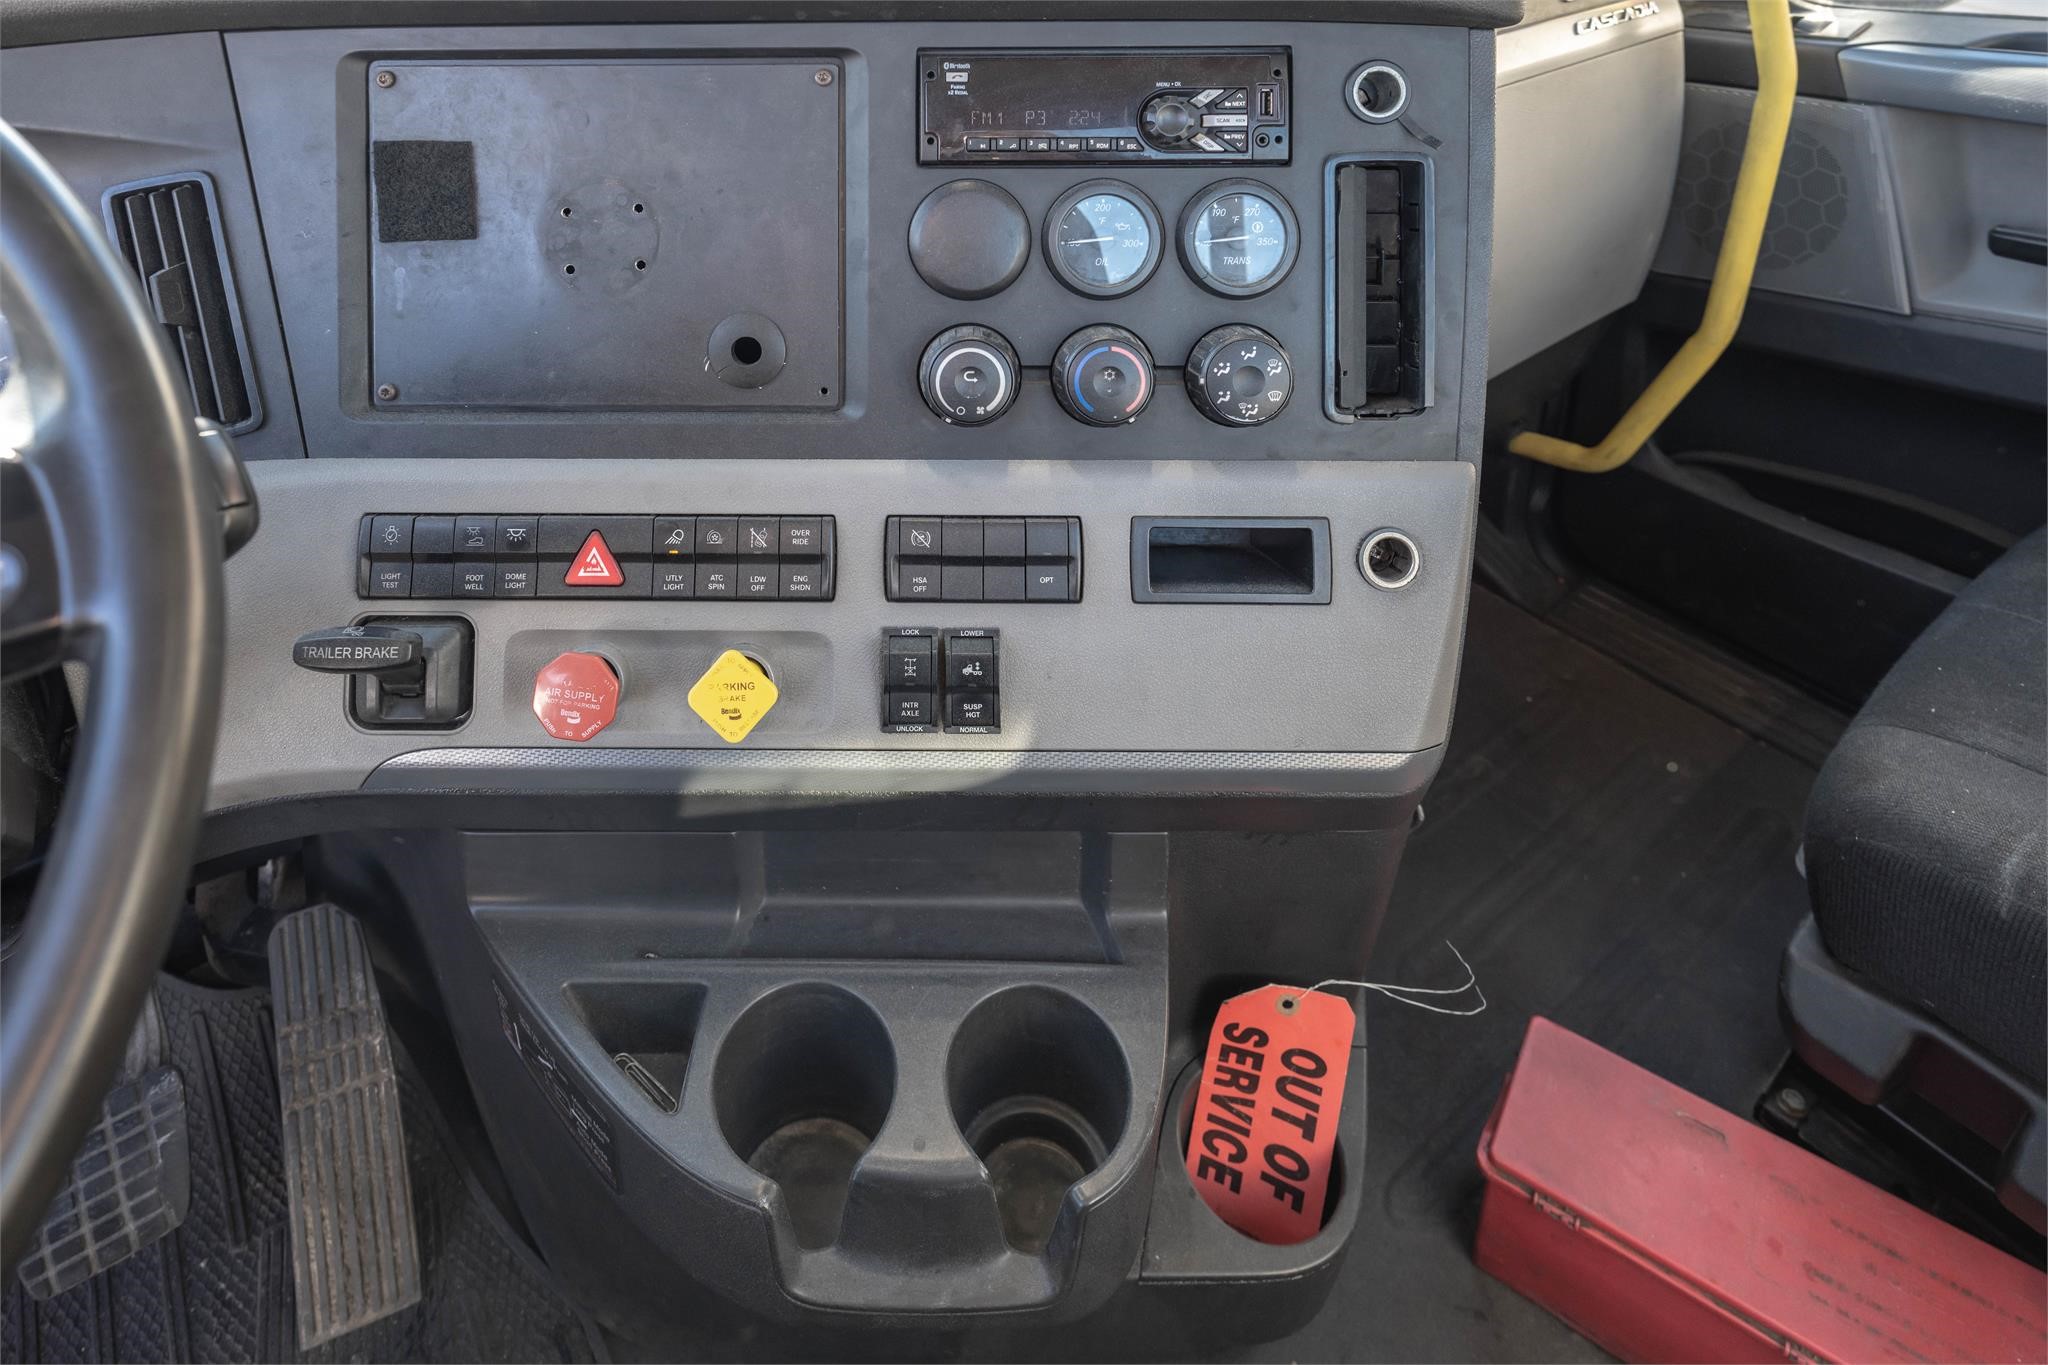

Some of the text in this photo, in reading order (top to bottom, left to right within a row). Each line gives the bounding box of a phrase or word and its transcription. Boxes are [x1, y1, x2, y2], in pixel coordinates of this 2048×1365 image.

[1574, 1, 1659, 34] CASCADIA
[1025, 110, 1046, 126] P3
[1095, 203, 1111, 212] 200
[1212, 208, 1227, 217] 190
[1245, 208, 1261, 217] 270
[1122, 239, 1139, 248] 300
[1256, 238, 1273, 246] 350
[1095, 257, 1109, 266] OIL
[1223, 256, 1252, 265] TRANS
[302, 646, 399, 659] TRAILER BRAKE
[545, 687, 606, 704] AIR SUPPLY
[963, 703, 983, 711] SUSP
[581, 720, 602, 738] SUPPLY
[1197, 1022, 1270, 1195] SERVICE
[1259, 1047, 1328, 1215] OUT OF
